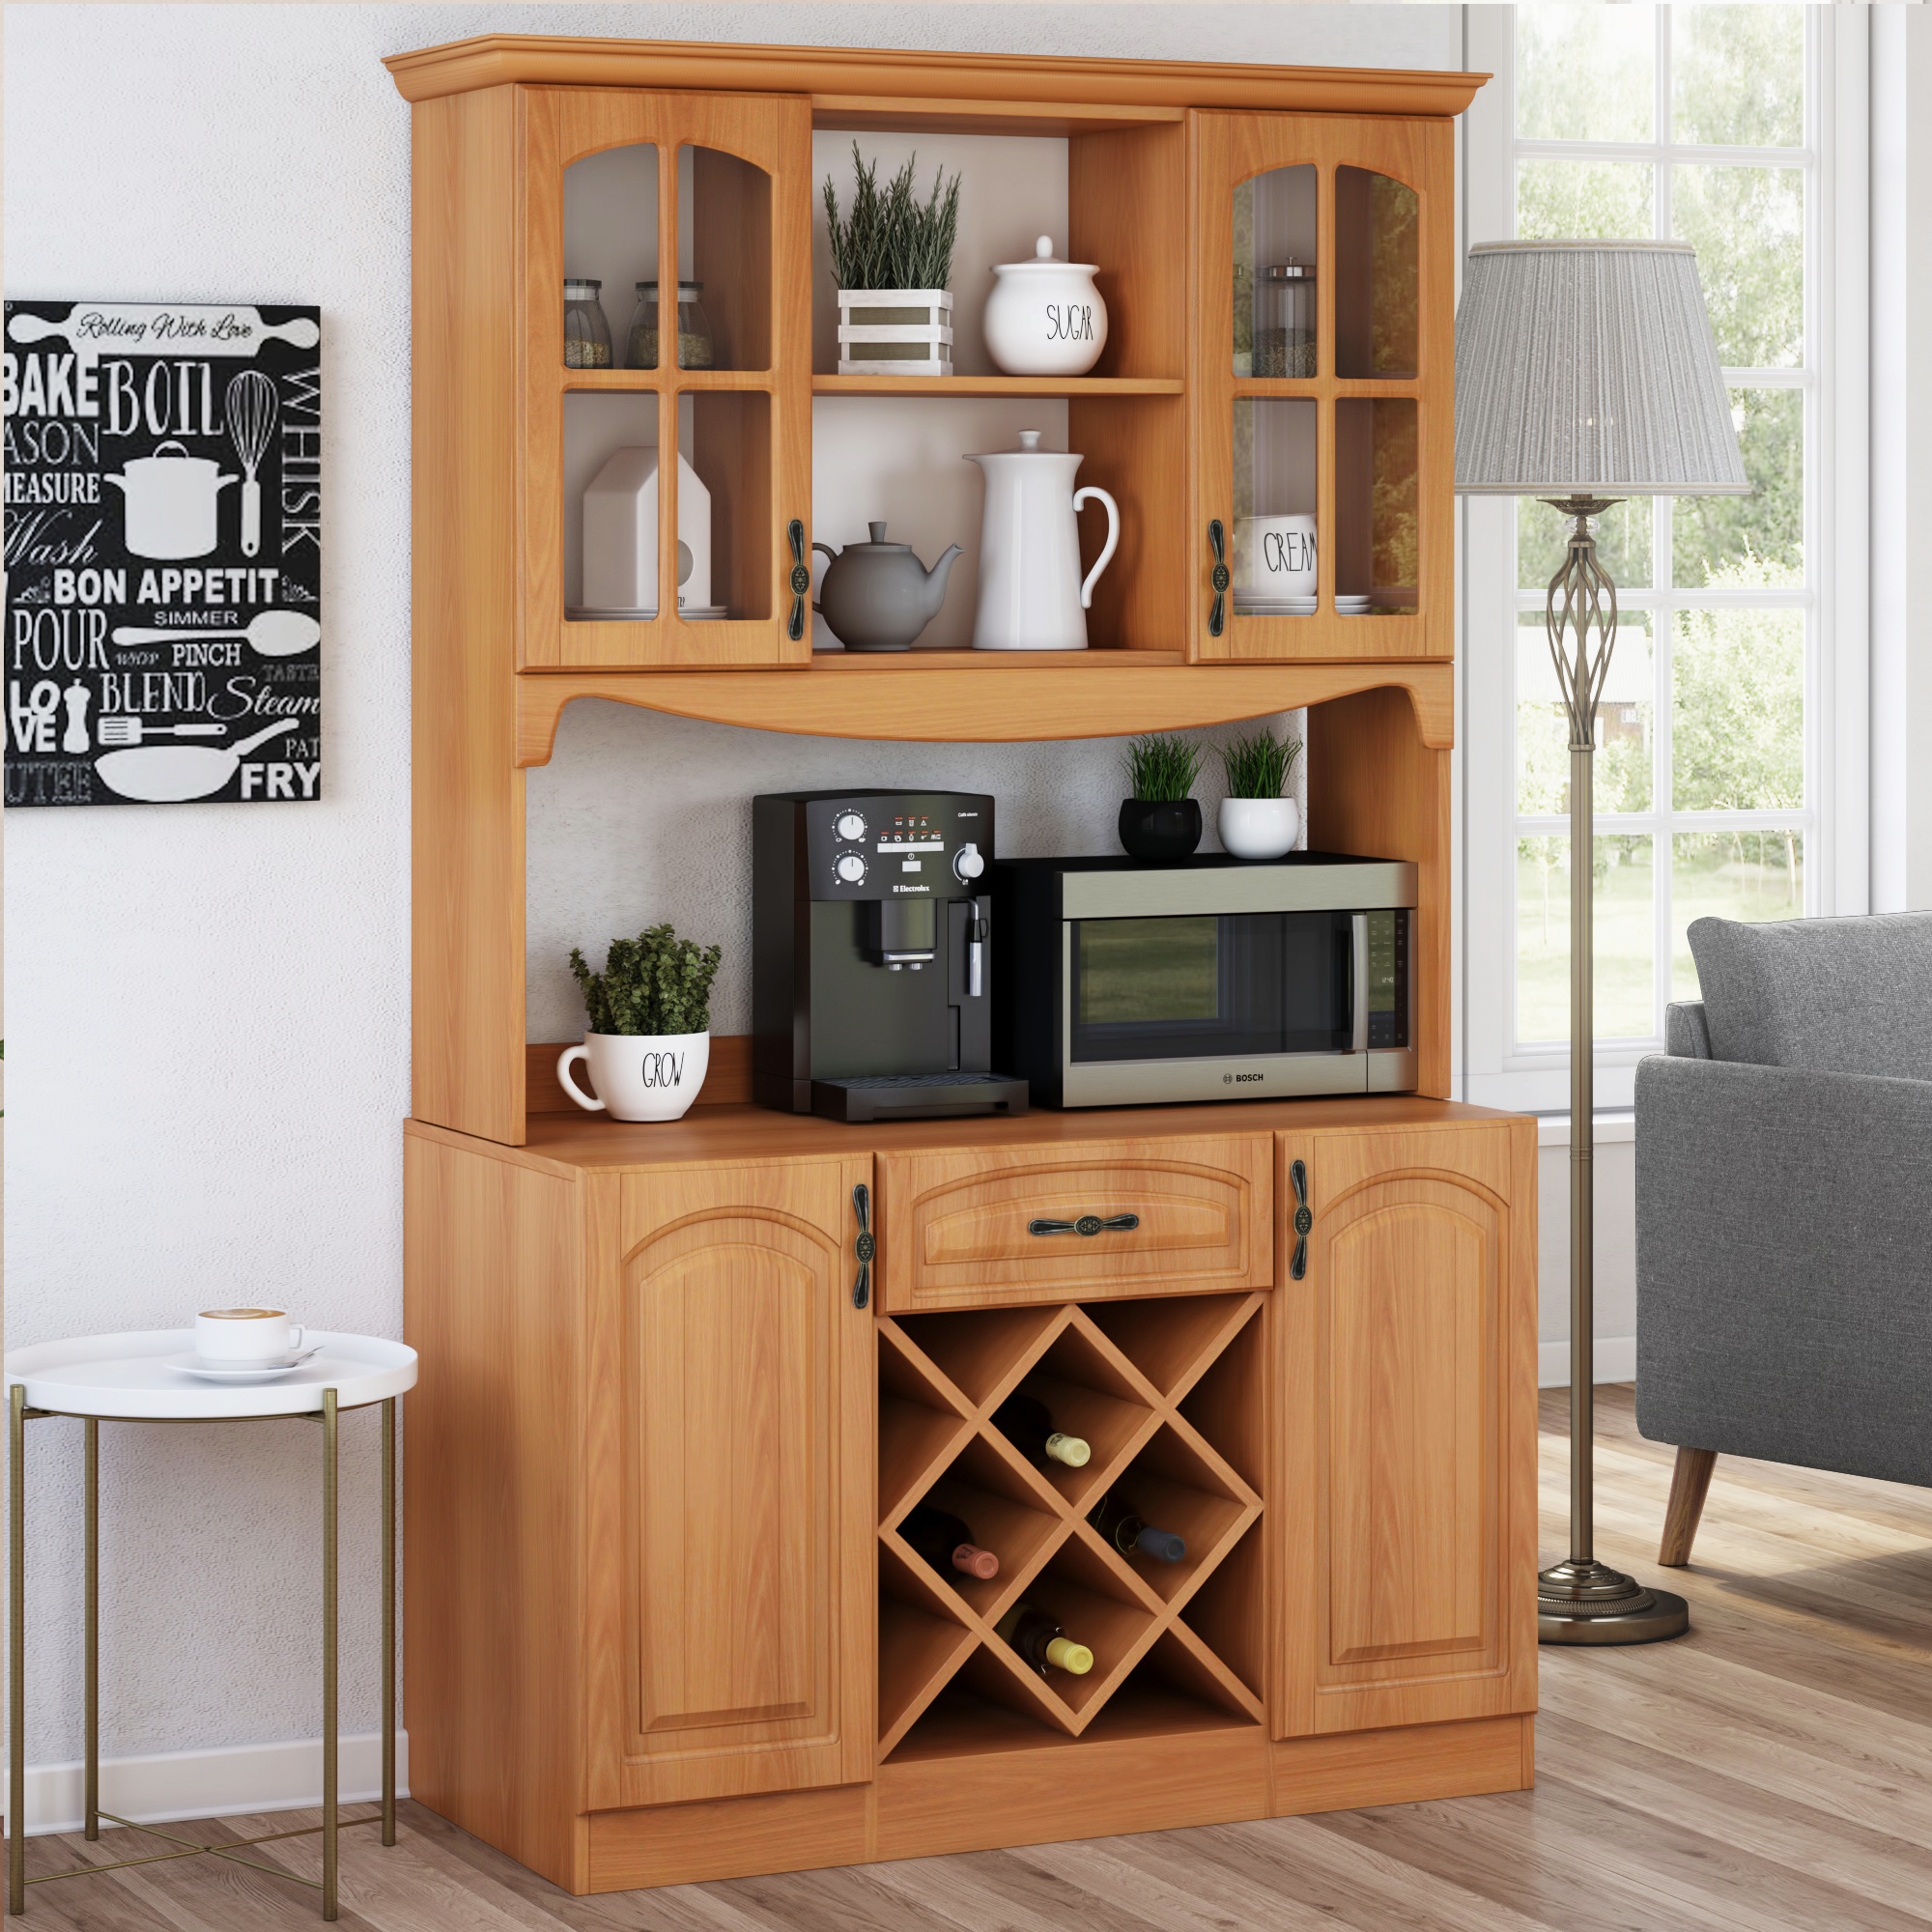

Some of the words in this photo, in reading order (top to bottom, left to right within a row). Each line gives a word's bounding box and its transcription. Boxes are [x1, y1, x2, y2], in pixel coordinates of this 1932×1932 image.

[76, 313, 147, 342] Rolling
[152, 314, 207, 339] With
[212, 315, 252, 340] Love
[1047, 305, 1093, 340] SUGAR
[4, 353, 99, 416] BAKE
[102, 360, 223, 436] BOIL
[281, 366, 321, 555] WHISK
[54, 569, 126, 605] BON
[137, 569, 278, 604] APPETIT
[156, 611, 238, 625] SIMMER
[14, 609, 109, 670] POUR
[172, 643, 241, 667] PINCH
[99, 671, 205, 713] BLEND
[206, 676, 320, 721] Steam
[242, 762, 320, 799] FRY
[899, 884, 930, 893] Electrolux
[642, 1053, 684, 1087] GROW
